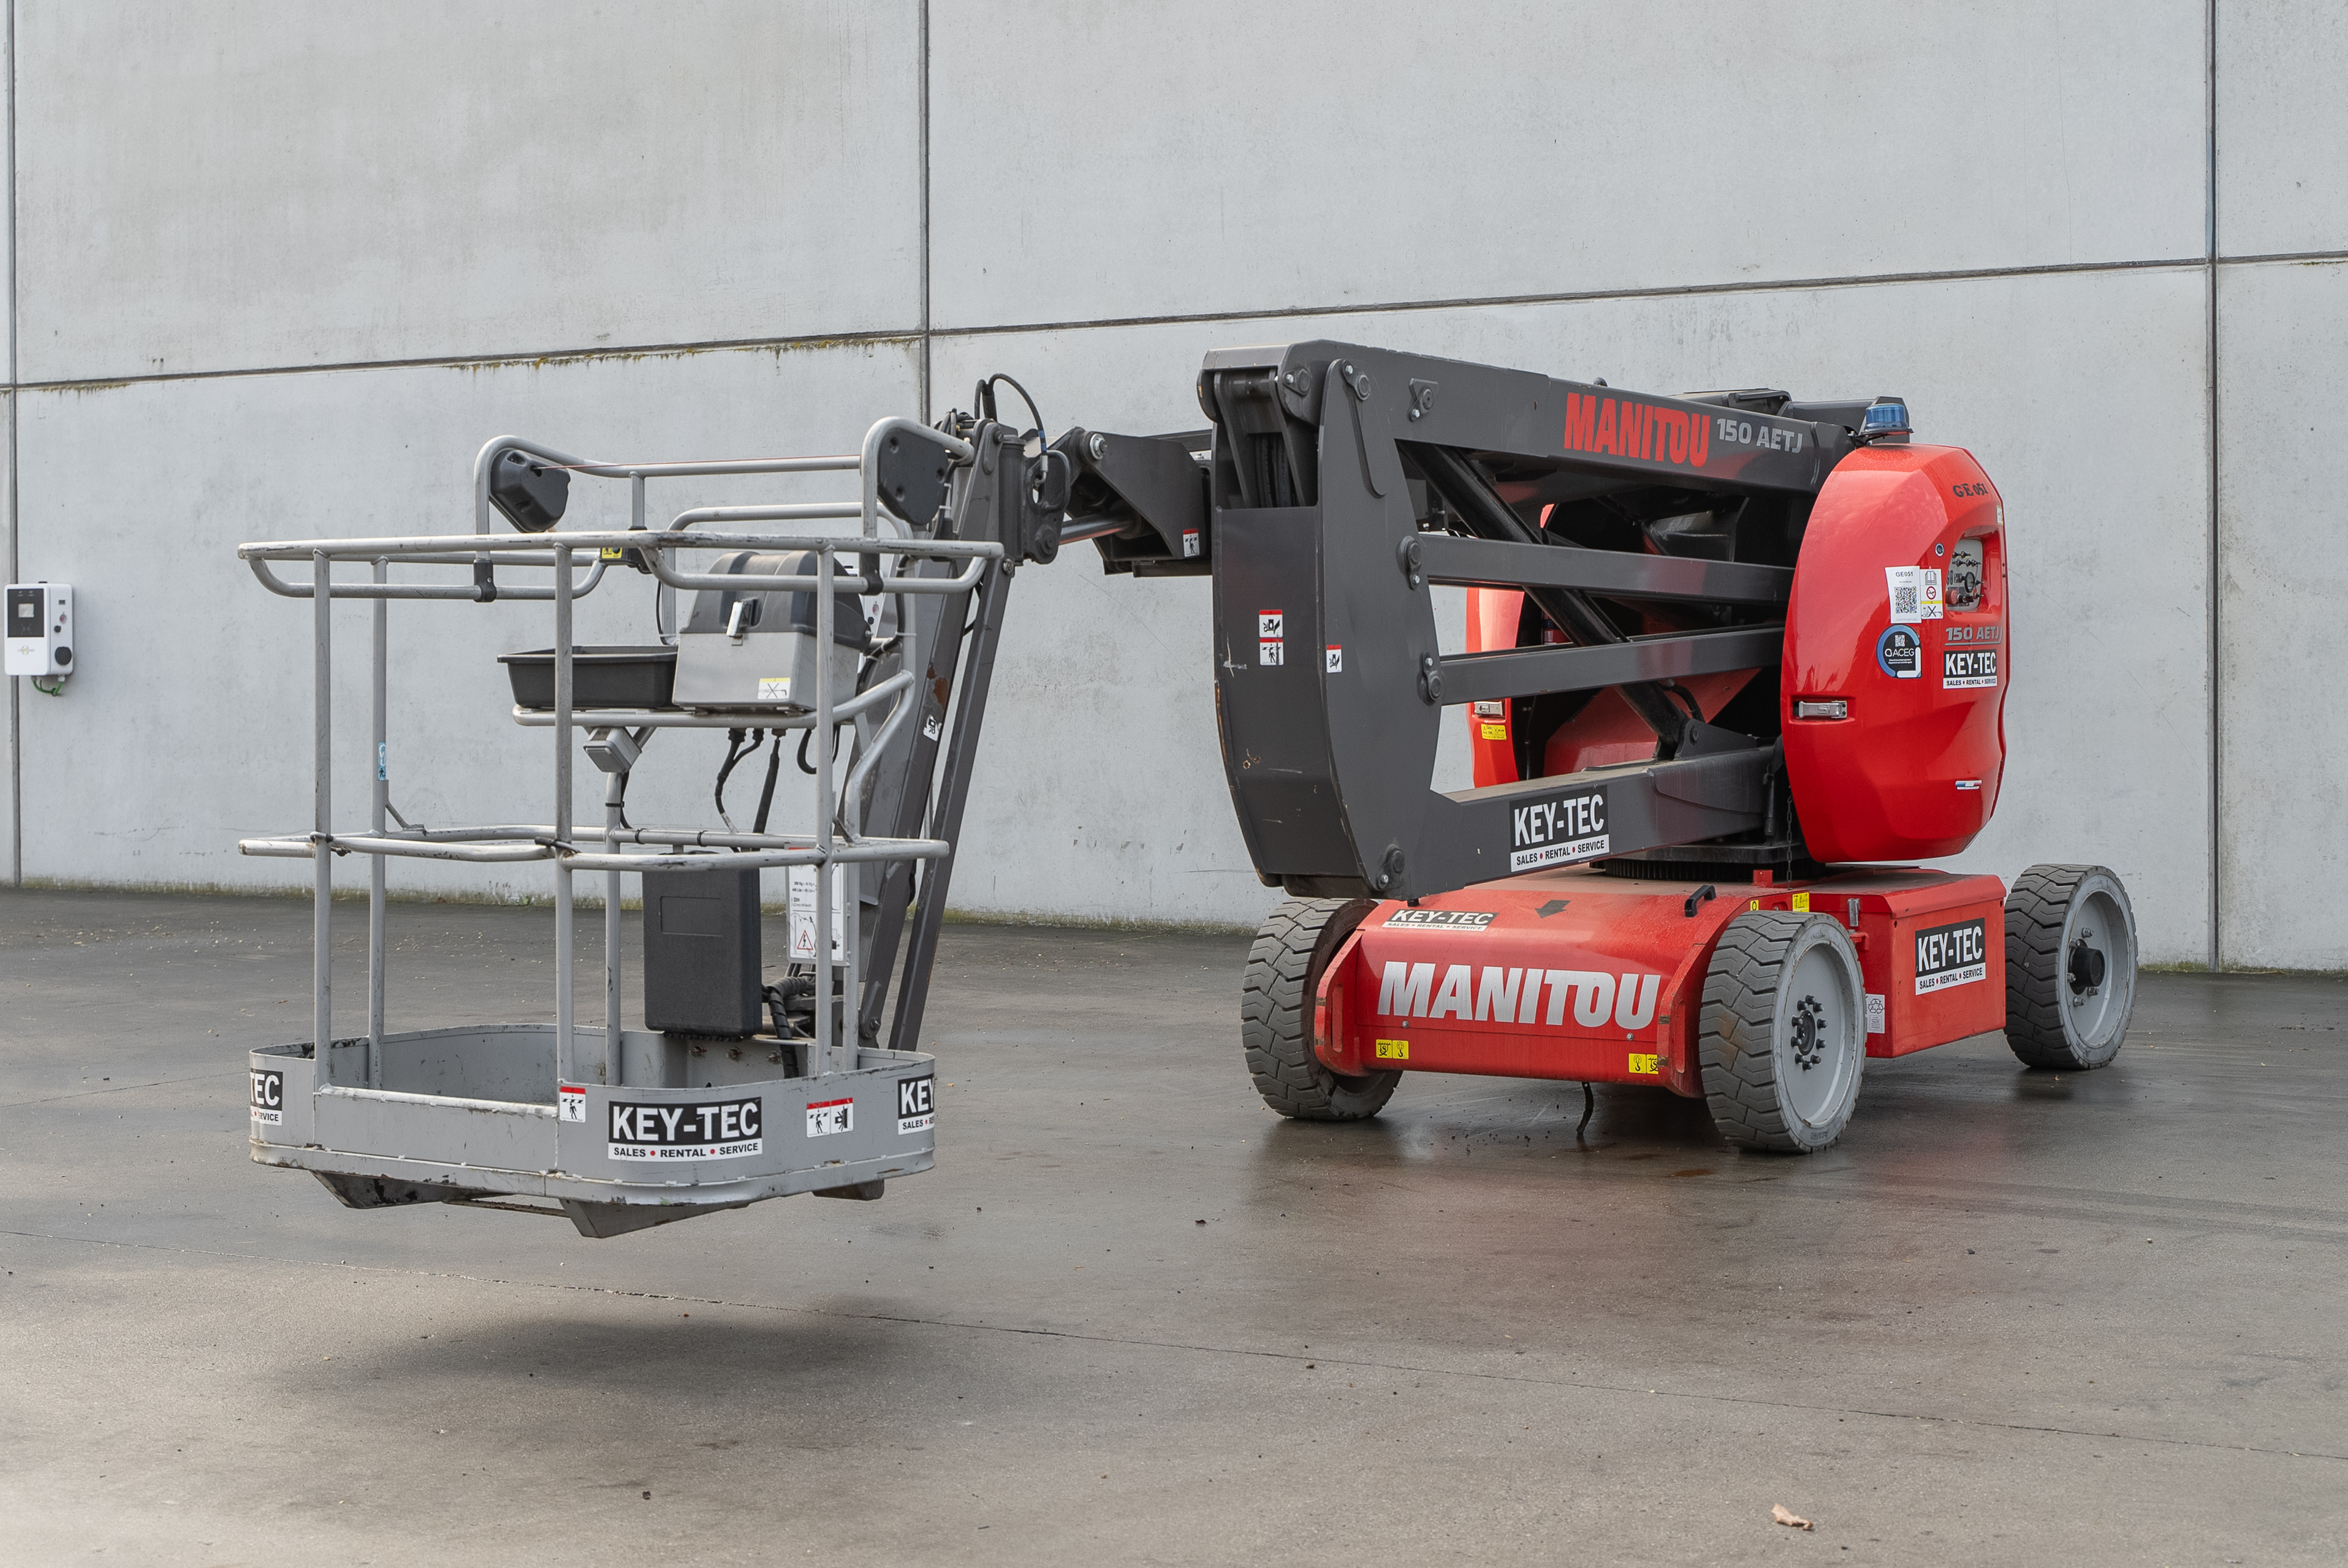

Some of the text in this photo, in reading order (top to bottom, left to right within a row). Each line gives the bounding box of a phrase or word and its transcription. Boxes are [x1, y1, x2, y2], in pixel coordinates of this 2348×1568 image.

[1563, 392, 1711, 468] MANITOU
[1717, 419, 1803, 453] 150 AETJ
[1953, 483, 1974, 498] GE
[1945, 626, 1999, 641] 150 AETJ
[1945, 651, 1996, 675] KEY-TEC
[1514, 794, 1605, 847] KEY-TEC
[1516, 840, 1605, 866] SALES RENTAL SERVICE
[1391, 910, 1494, 925] KEY-TEC
[1918, 926, 1983, 972] KEY-TEC
[1919, 967, 1983, 990] SALES RENTAL SERVICE
[1377, 961, 1661, 1030] MANITOU
[613, 1102, 759, 1142] KEY-TEC
[902, 1119, 924, 1131] SALES
[614, 1143, 758, 1158] SALES RENTAL SERVICE
